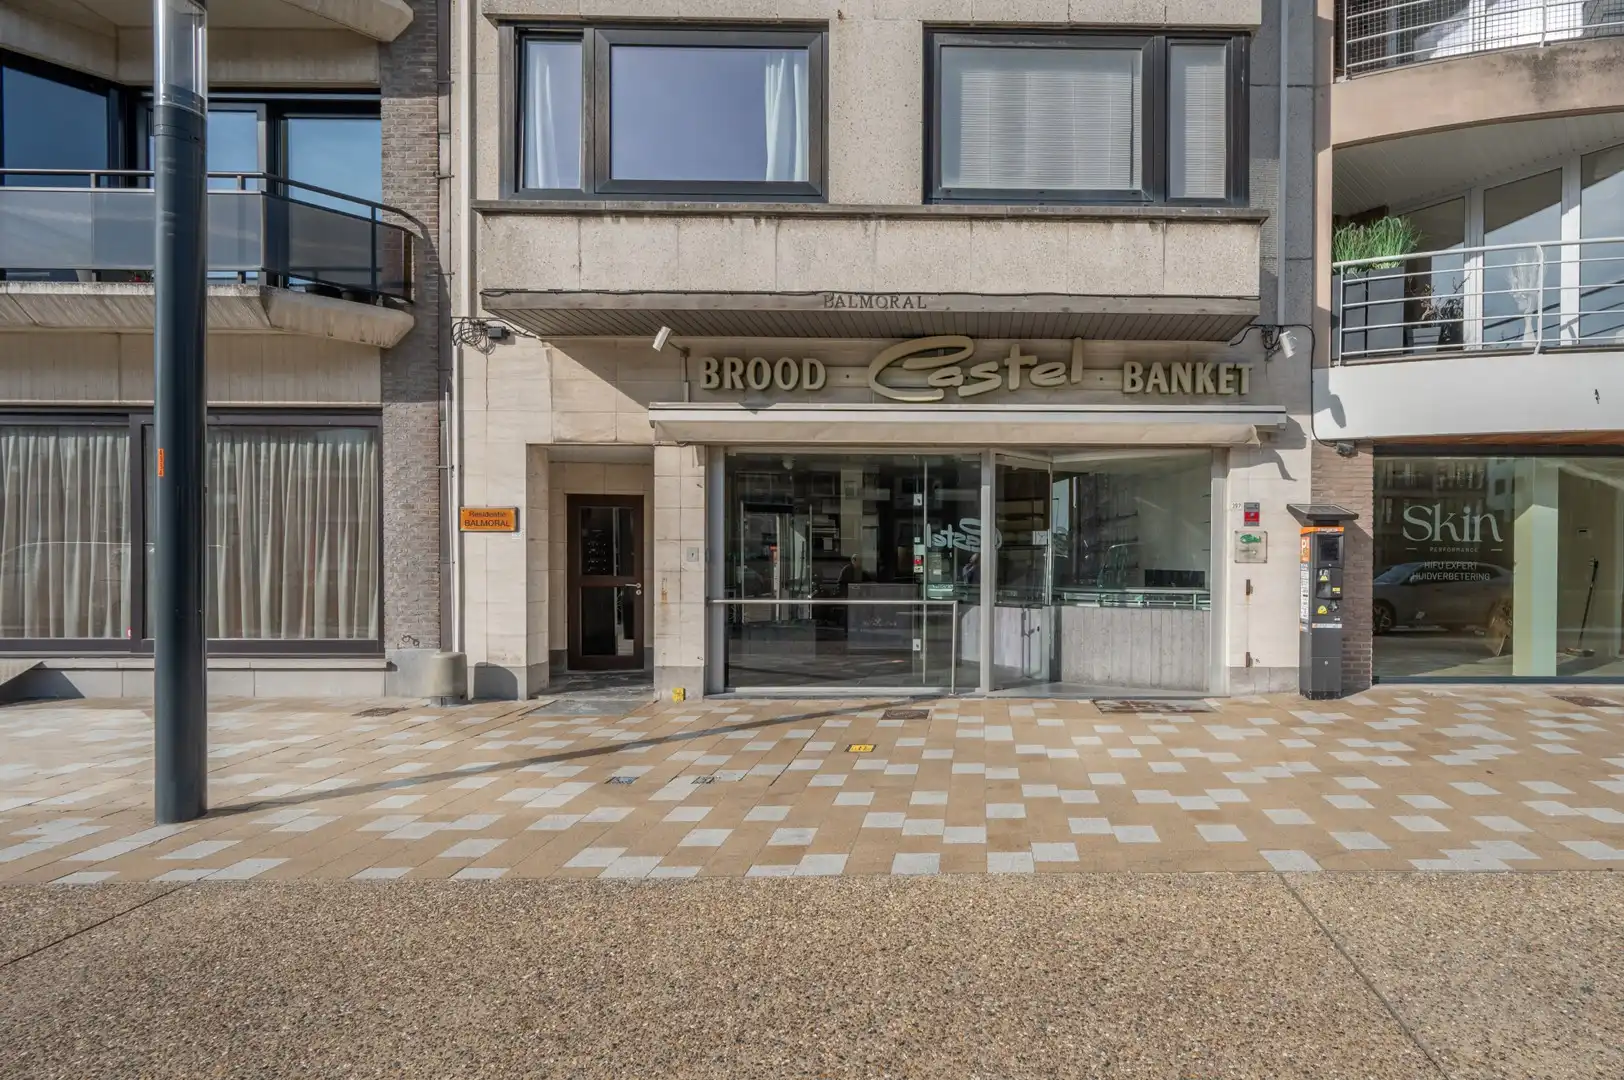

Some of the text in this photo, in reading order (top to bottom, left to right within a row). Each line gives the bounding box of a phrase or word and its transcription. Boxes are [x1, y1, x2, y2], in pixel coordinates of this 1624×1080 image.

[824, 294, 927, 310] BALMORAL
[700, 335, 1253, 402] BROOD Castel BANKET
[464, 519, 510, 527] BALMORAL
[1402, 503, 1503, 542] Skin
[1424, 561, 1478, 570] HIFU EXPERT
[1412, 572, 1490, 582] HUIDVERBETERING
